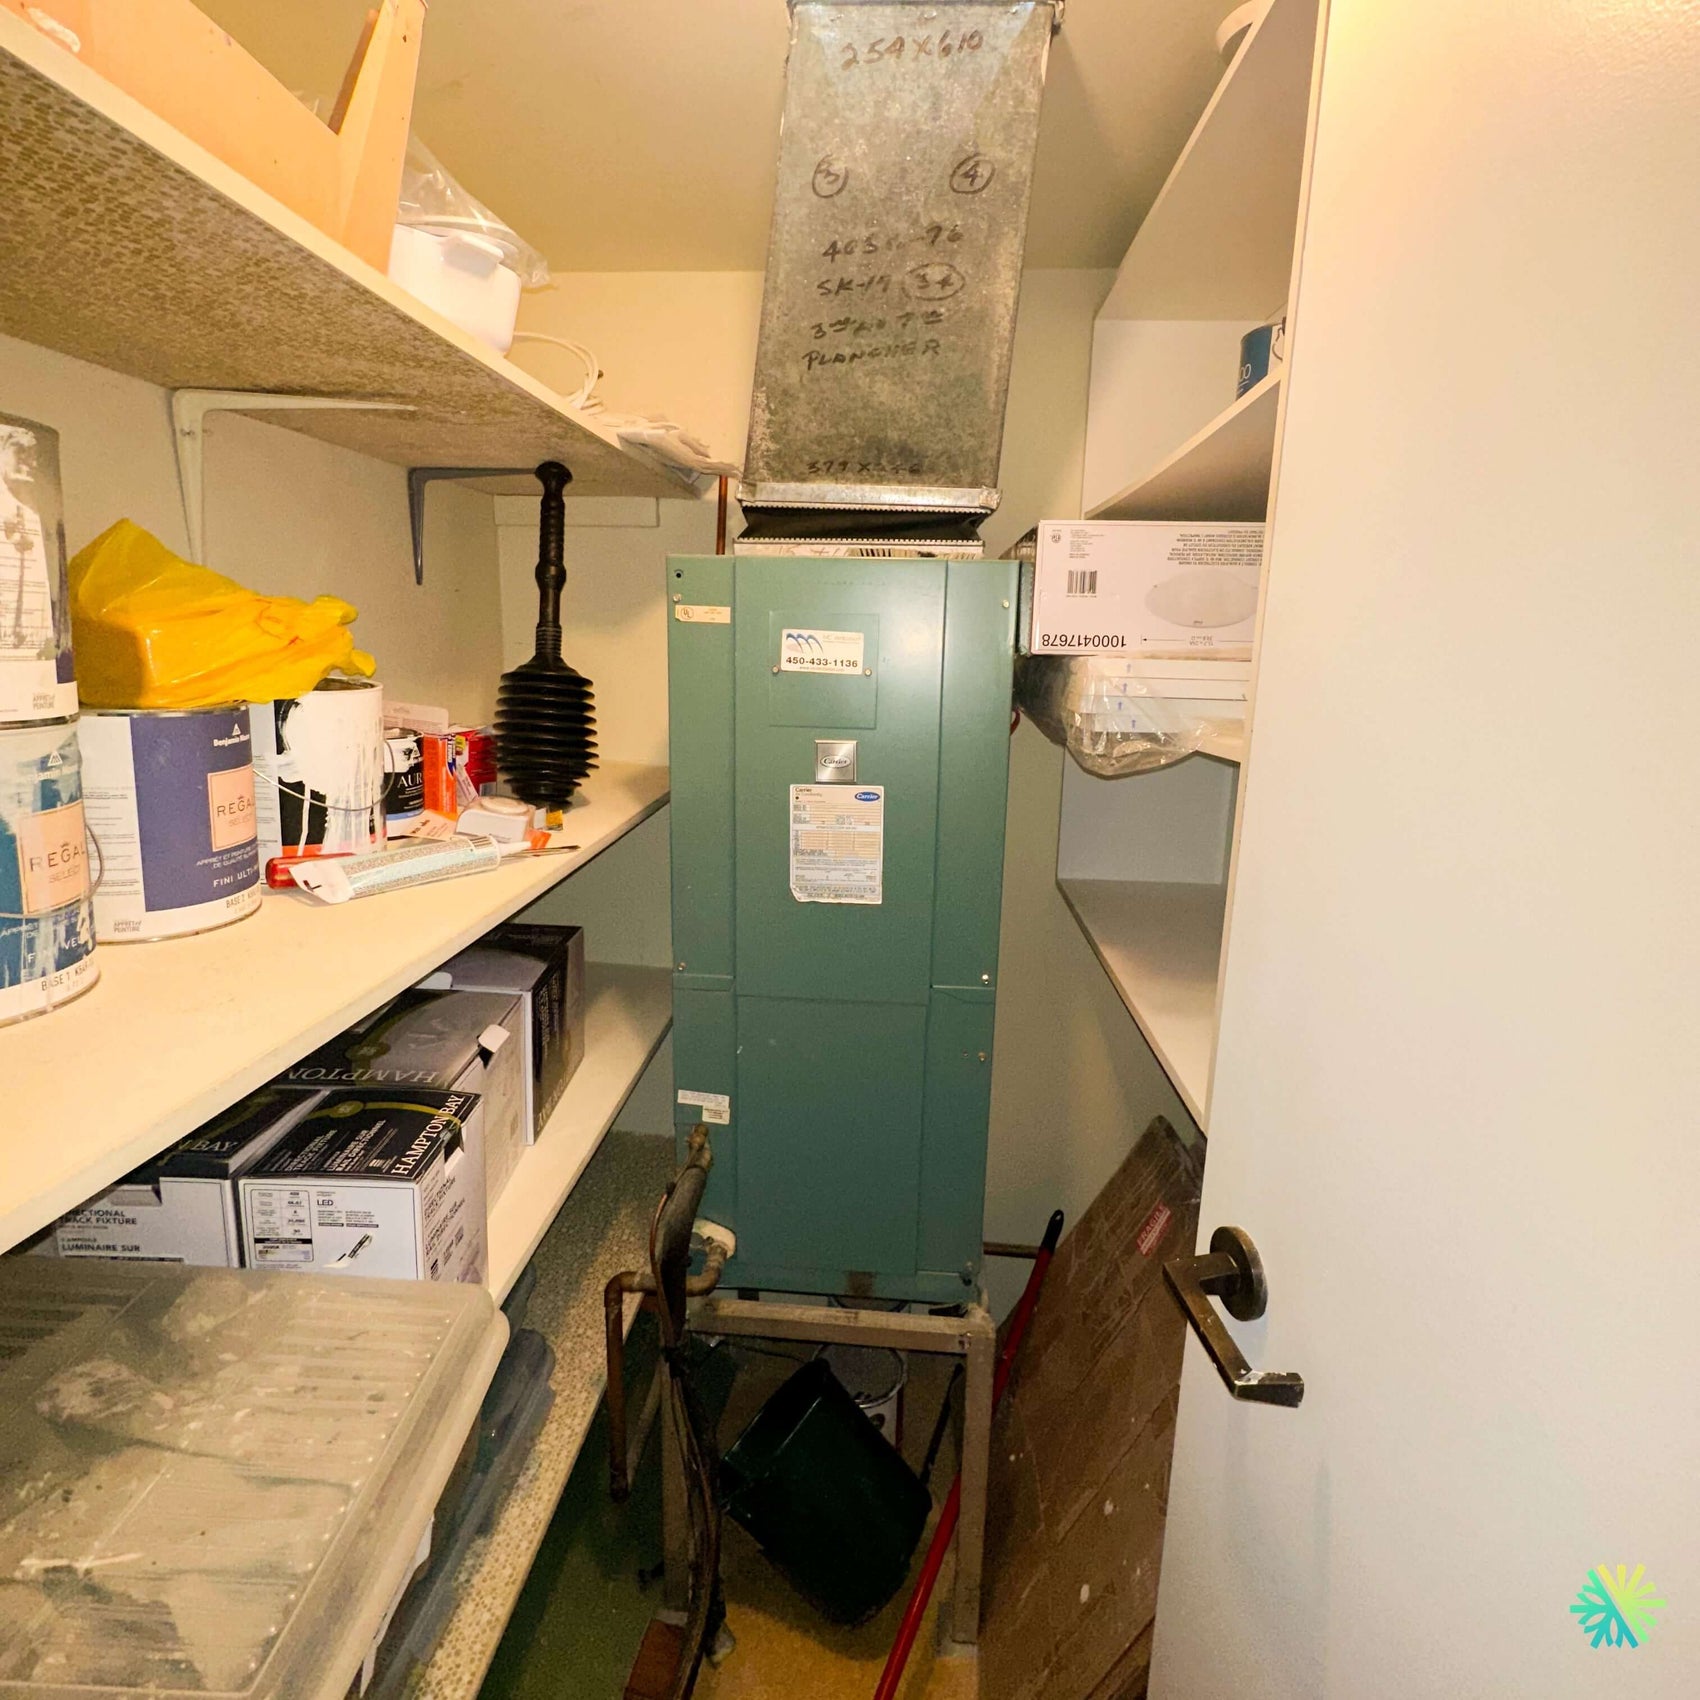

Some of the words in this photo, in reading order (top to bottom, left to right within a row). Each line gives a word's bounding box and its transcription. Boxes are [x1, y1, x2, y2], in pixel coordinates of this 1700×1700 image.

[1041, 633, 1128, 648] 1000417678
[785, 656, 859, 668] 450-433-1136
[823, 756, 848, 765] Carrier
[396, 772, 423, 788] AUR
[855, 793, 880, 801] Carrier
[213, 874, 234, 888] FINI
[390, 1115, 450, 1175] HAMPTON
[439, 1094, 466, 1115] BAY
[190, 1139, 238, 1151] BAY
[316, 1199, 334, 1207] LED
[96, 1217, 138, 1226] FIXTURE
[62, 1243, 118, 1252] LUMINAIRE
[121, 1244, 141, 1252] SUR
